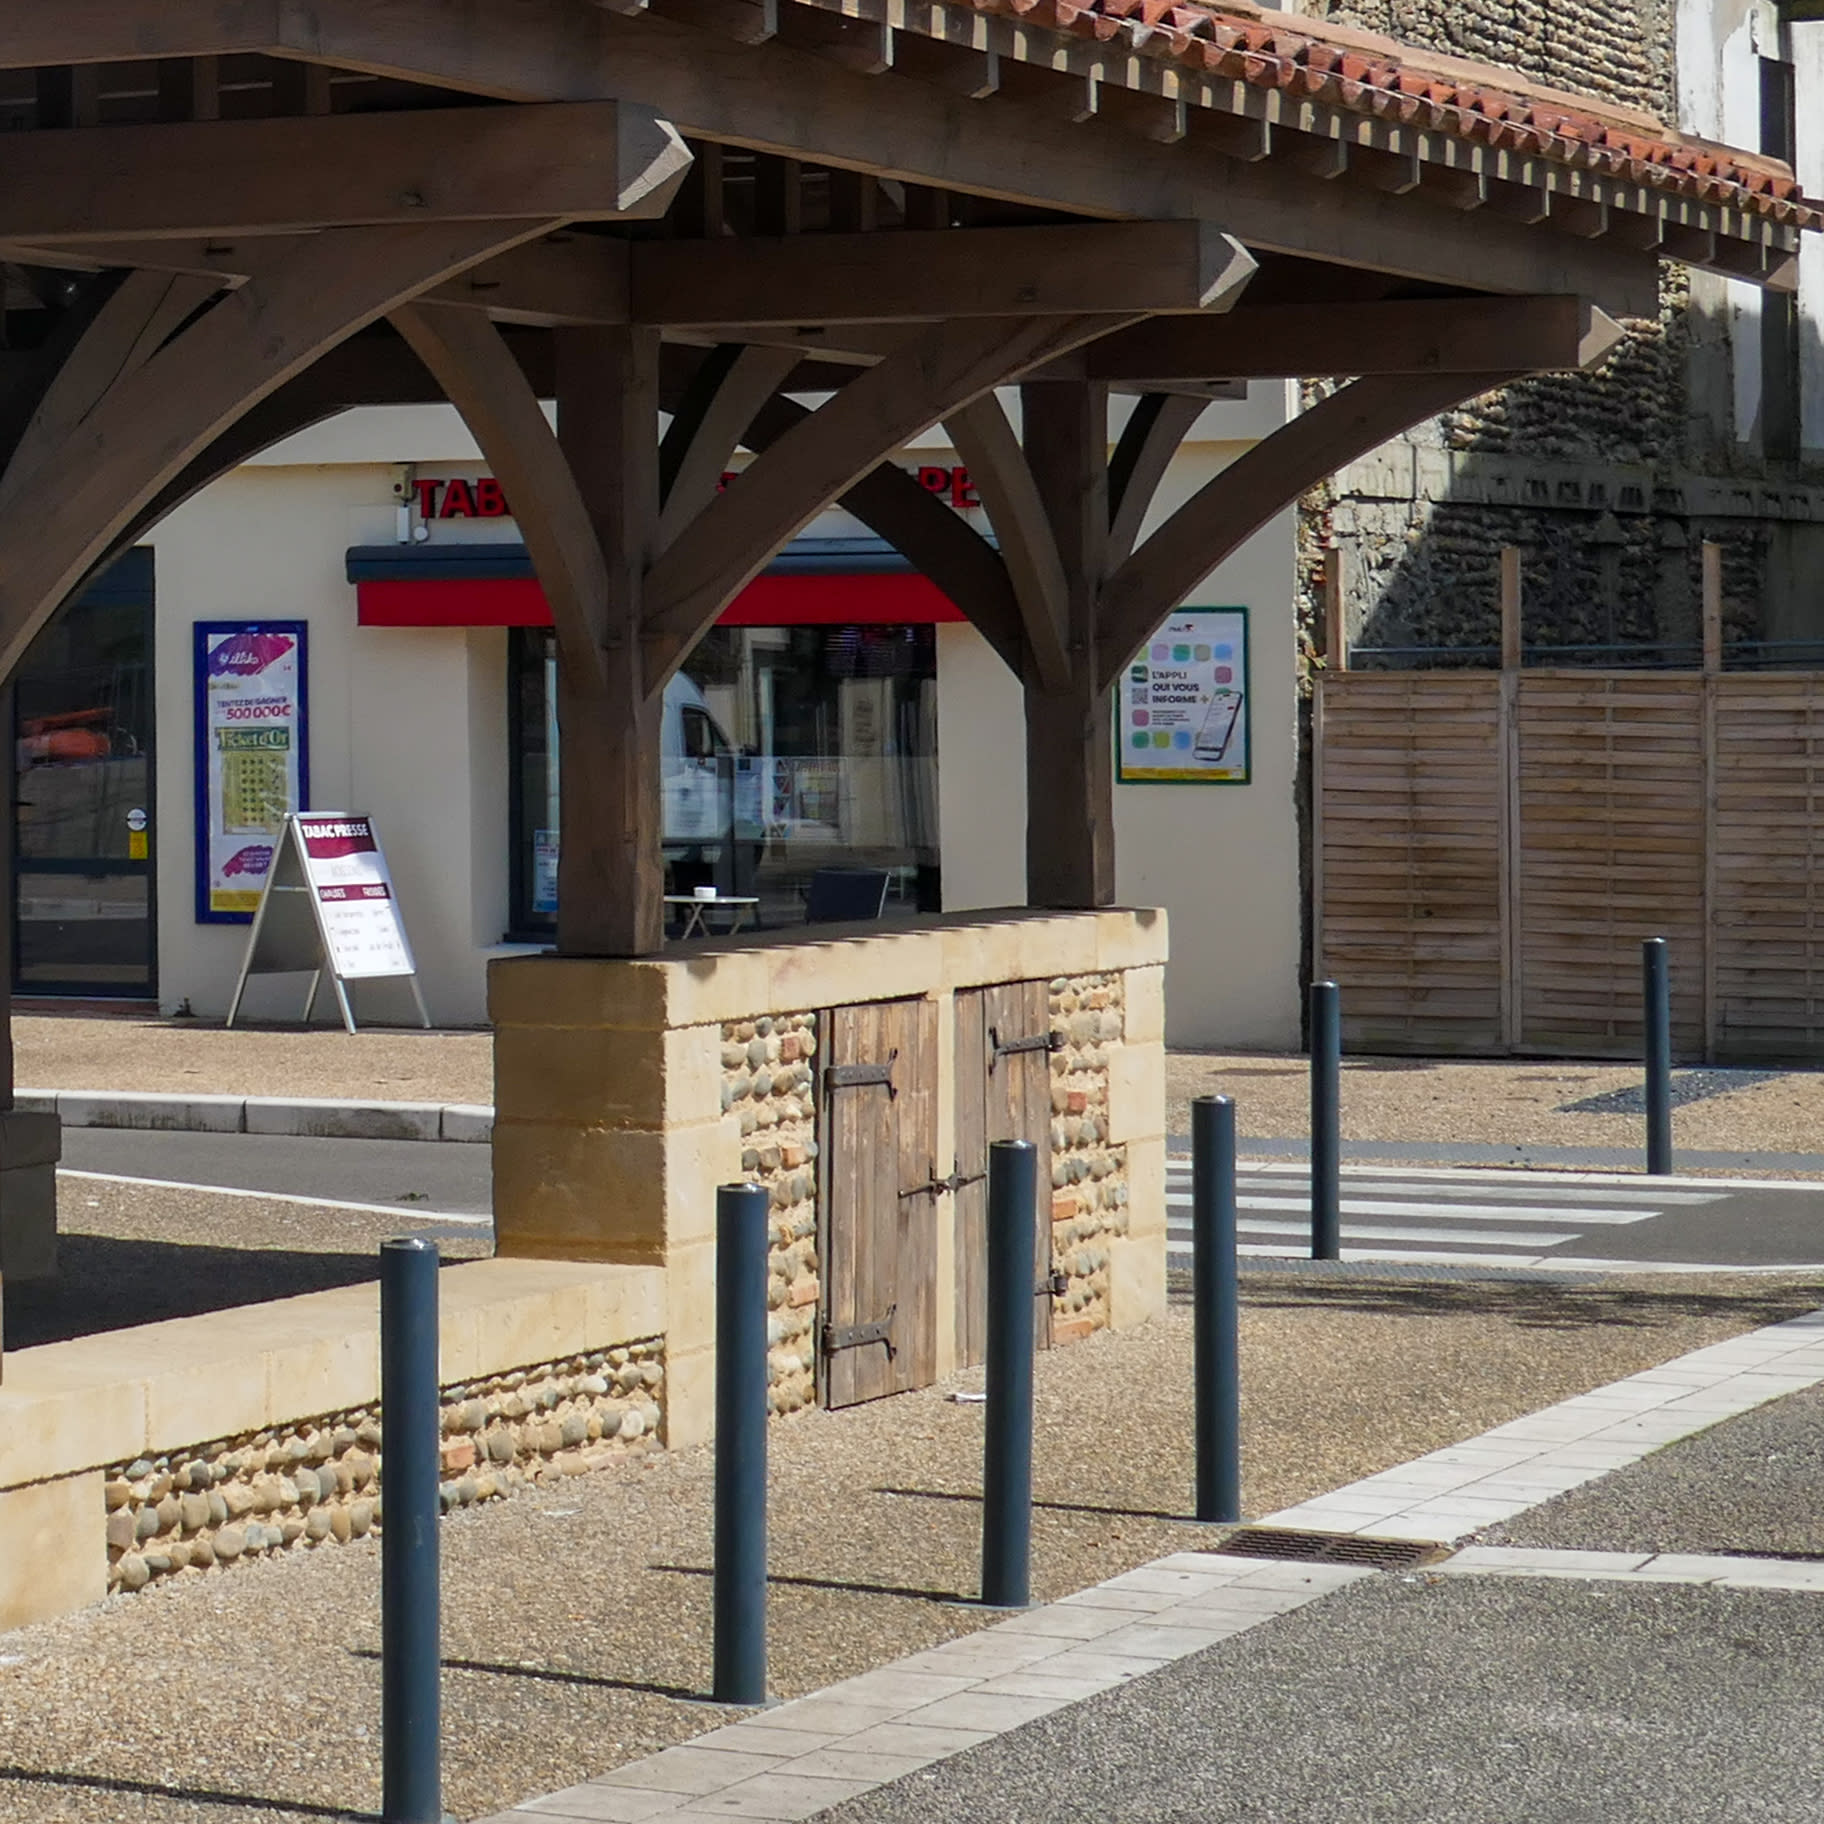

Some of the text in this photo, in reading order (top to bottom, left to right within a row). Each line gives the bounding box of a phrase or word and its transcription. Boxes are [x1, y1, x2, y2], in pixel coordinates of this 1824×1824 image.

[412, 478, 508, 519] TAB
[1152, 671, 1187, 680] L'APPLI
[1152, 683, 1200, 692] QUI VOUS
[1152, 695, 1197, 704] INFORME
[226, 708, 251, 720] 500
[302, 824, 369, 838] TABAC PRESSE
